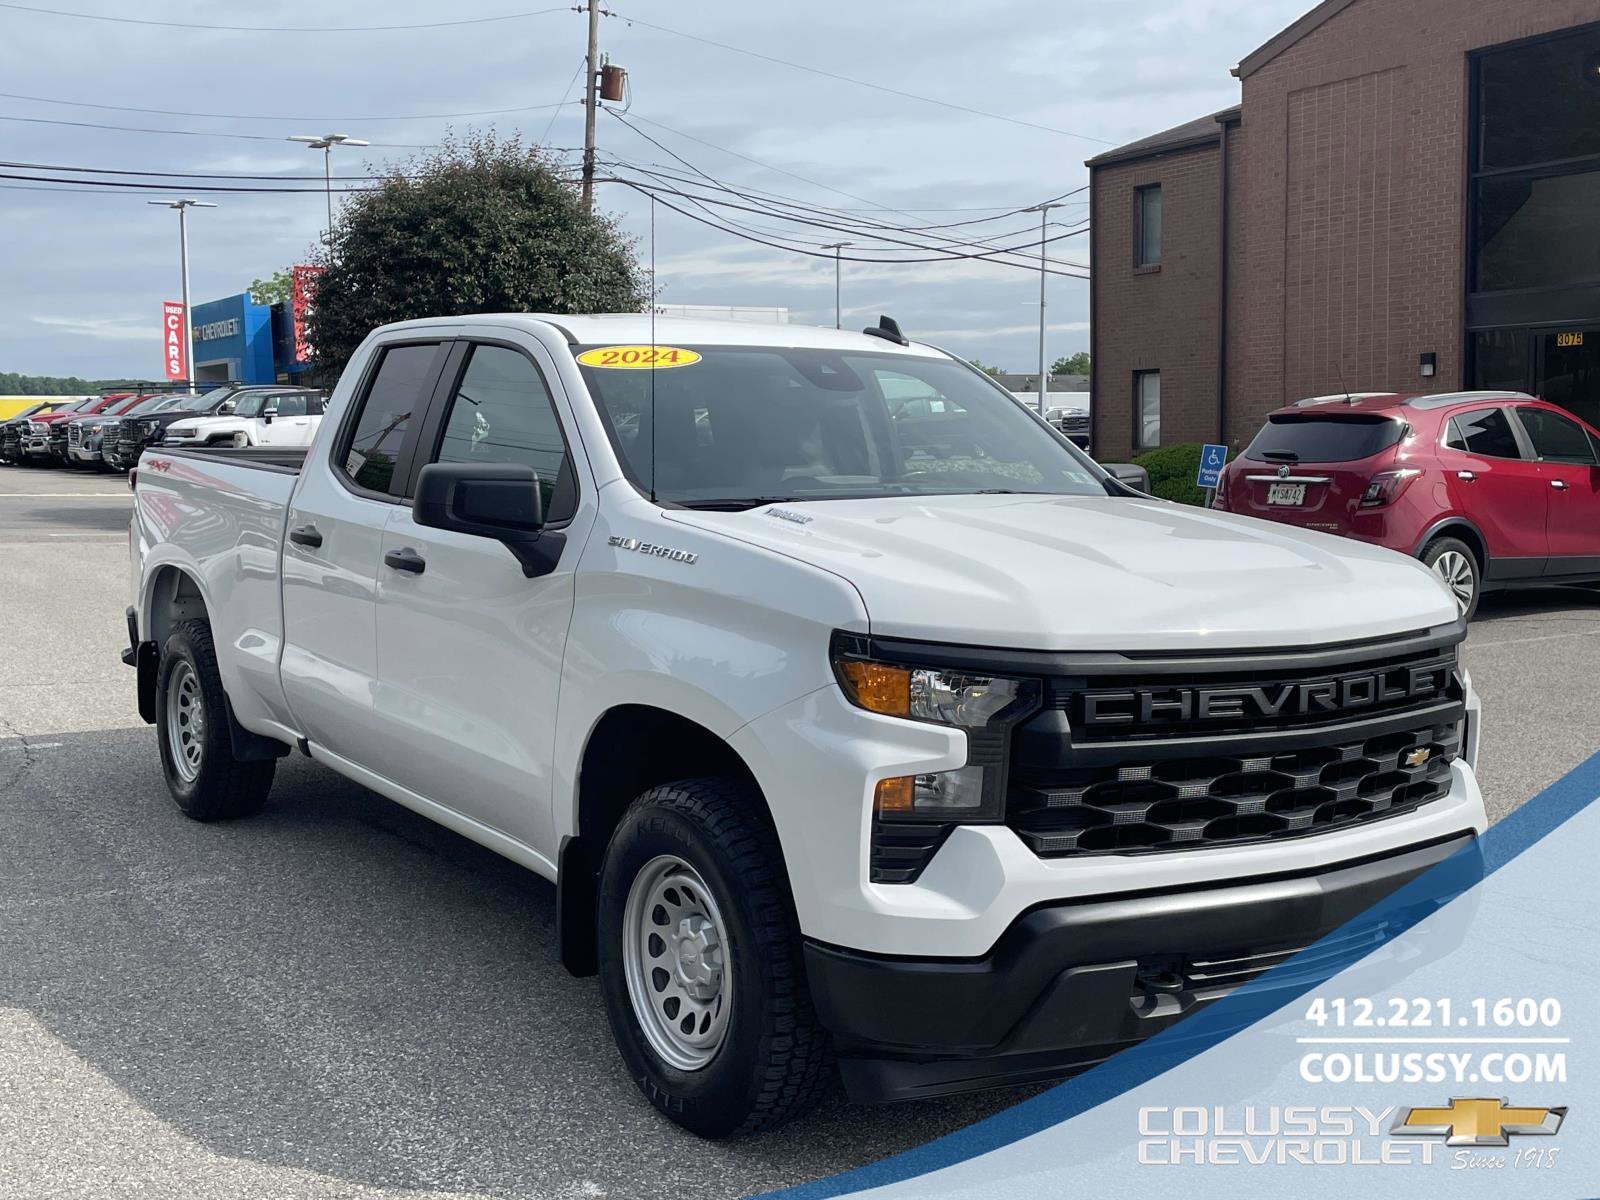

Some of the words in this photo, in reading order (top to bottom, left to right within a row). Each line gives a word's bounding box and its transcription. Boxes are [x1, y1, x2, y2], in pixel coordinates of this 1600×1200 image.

[165, 306, 182, 314] USED
[202, 318, 239, 341] CHEVROLET
[1558, 333, 1582, 345] 3075
[167, 315, 180, 375] CARS
[601, 350, 680, 365] 2024
[1204, 475, 1217, 483] Only
[607, 535, 698, 565] SILVERADO
[1084, 667, 1456, 723] CHEVROLET
